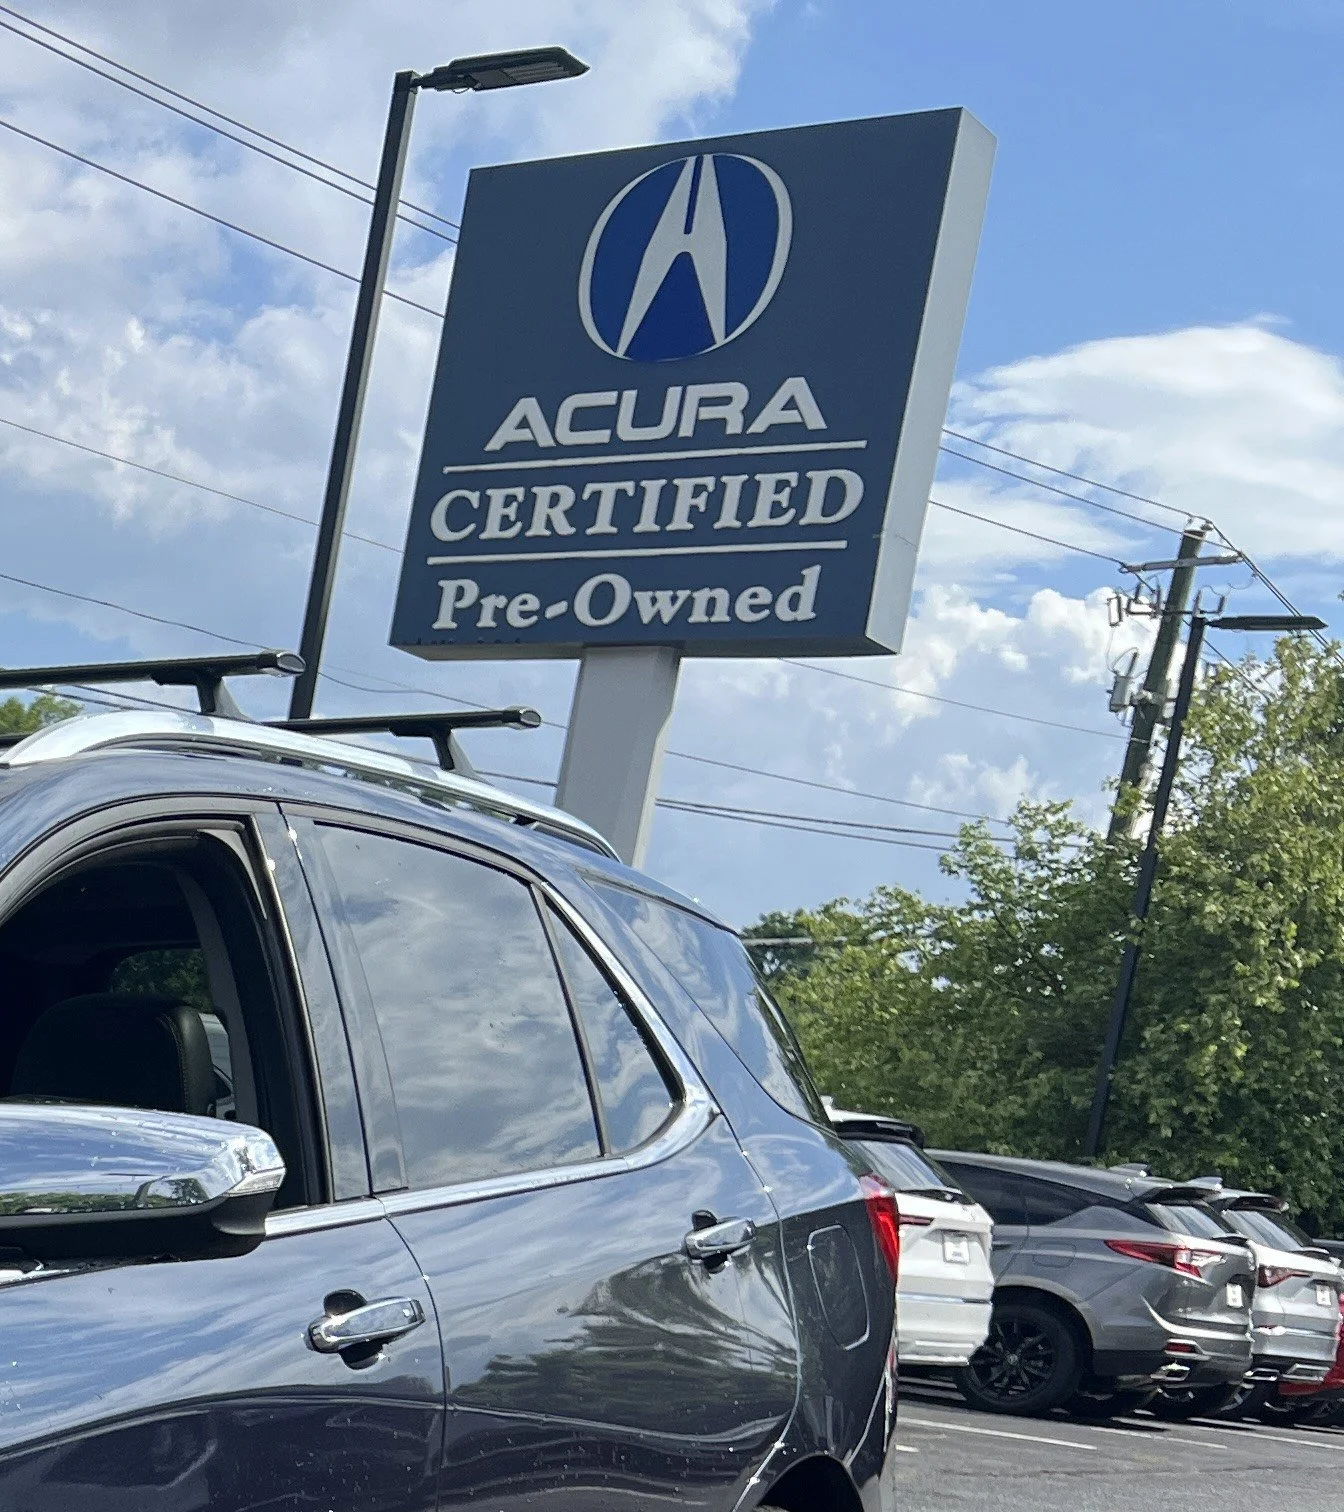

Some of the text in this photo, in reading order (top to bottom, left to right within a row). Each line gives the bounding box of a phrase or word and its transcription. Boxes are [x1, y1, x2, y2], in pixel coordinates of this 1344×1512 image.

[484, 375, 828, 452] ACURA
[429, 467, 866, 543] CERTIFIED
[431, 564, 823, 631] Pre-Owned
